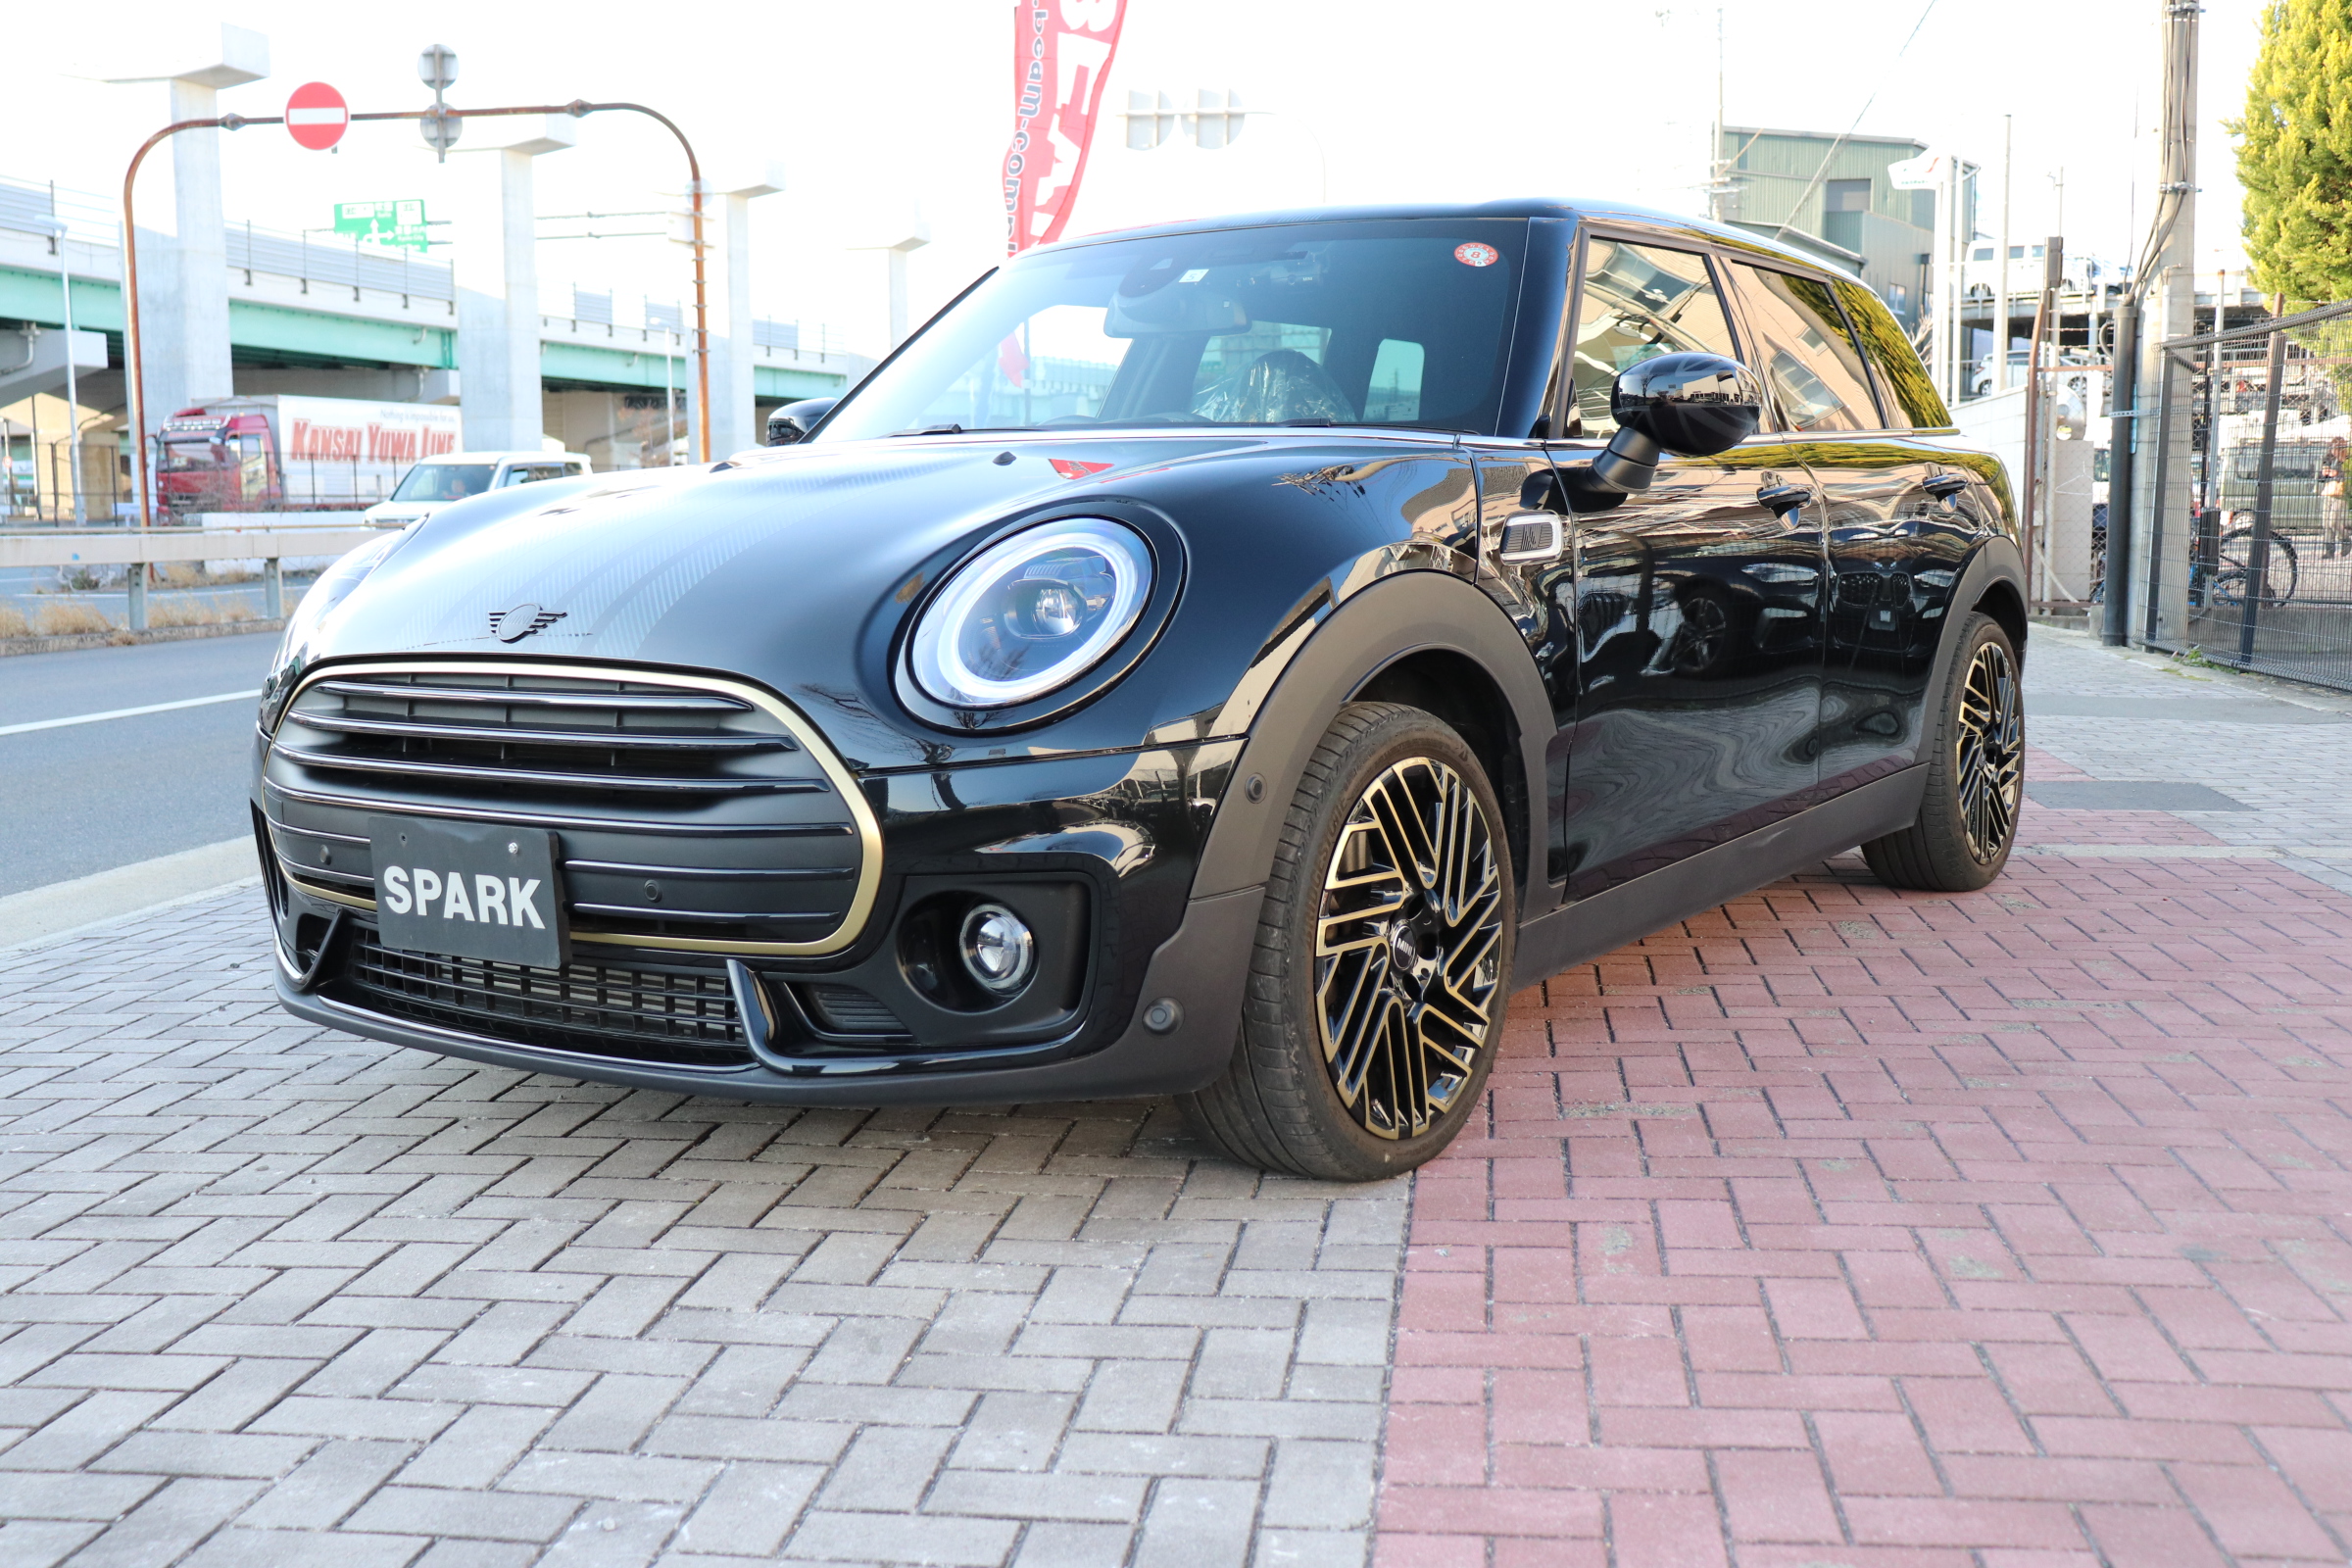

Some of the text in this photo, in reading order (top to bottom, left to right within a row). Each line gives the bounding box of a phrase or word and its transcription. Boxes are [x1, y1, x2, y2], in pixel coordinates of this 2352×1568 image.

[290, 418, 456, 465] KANSAI YUWA LINE
[383, 865, 546, 930] SPARK
